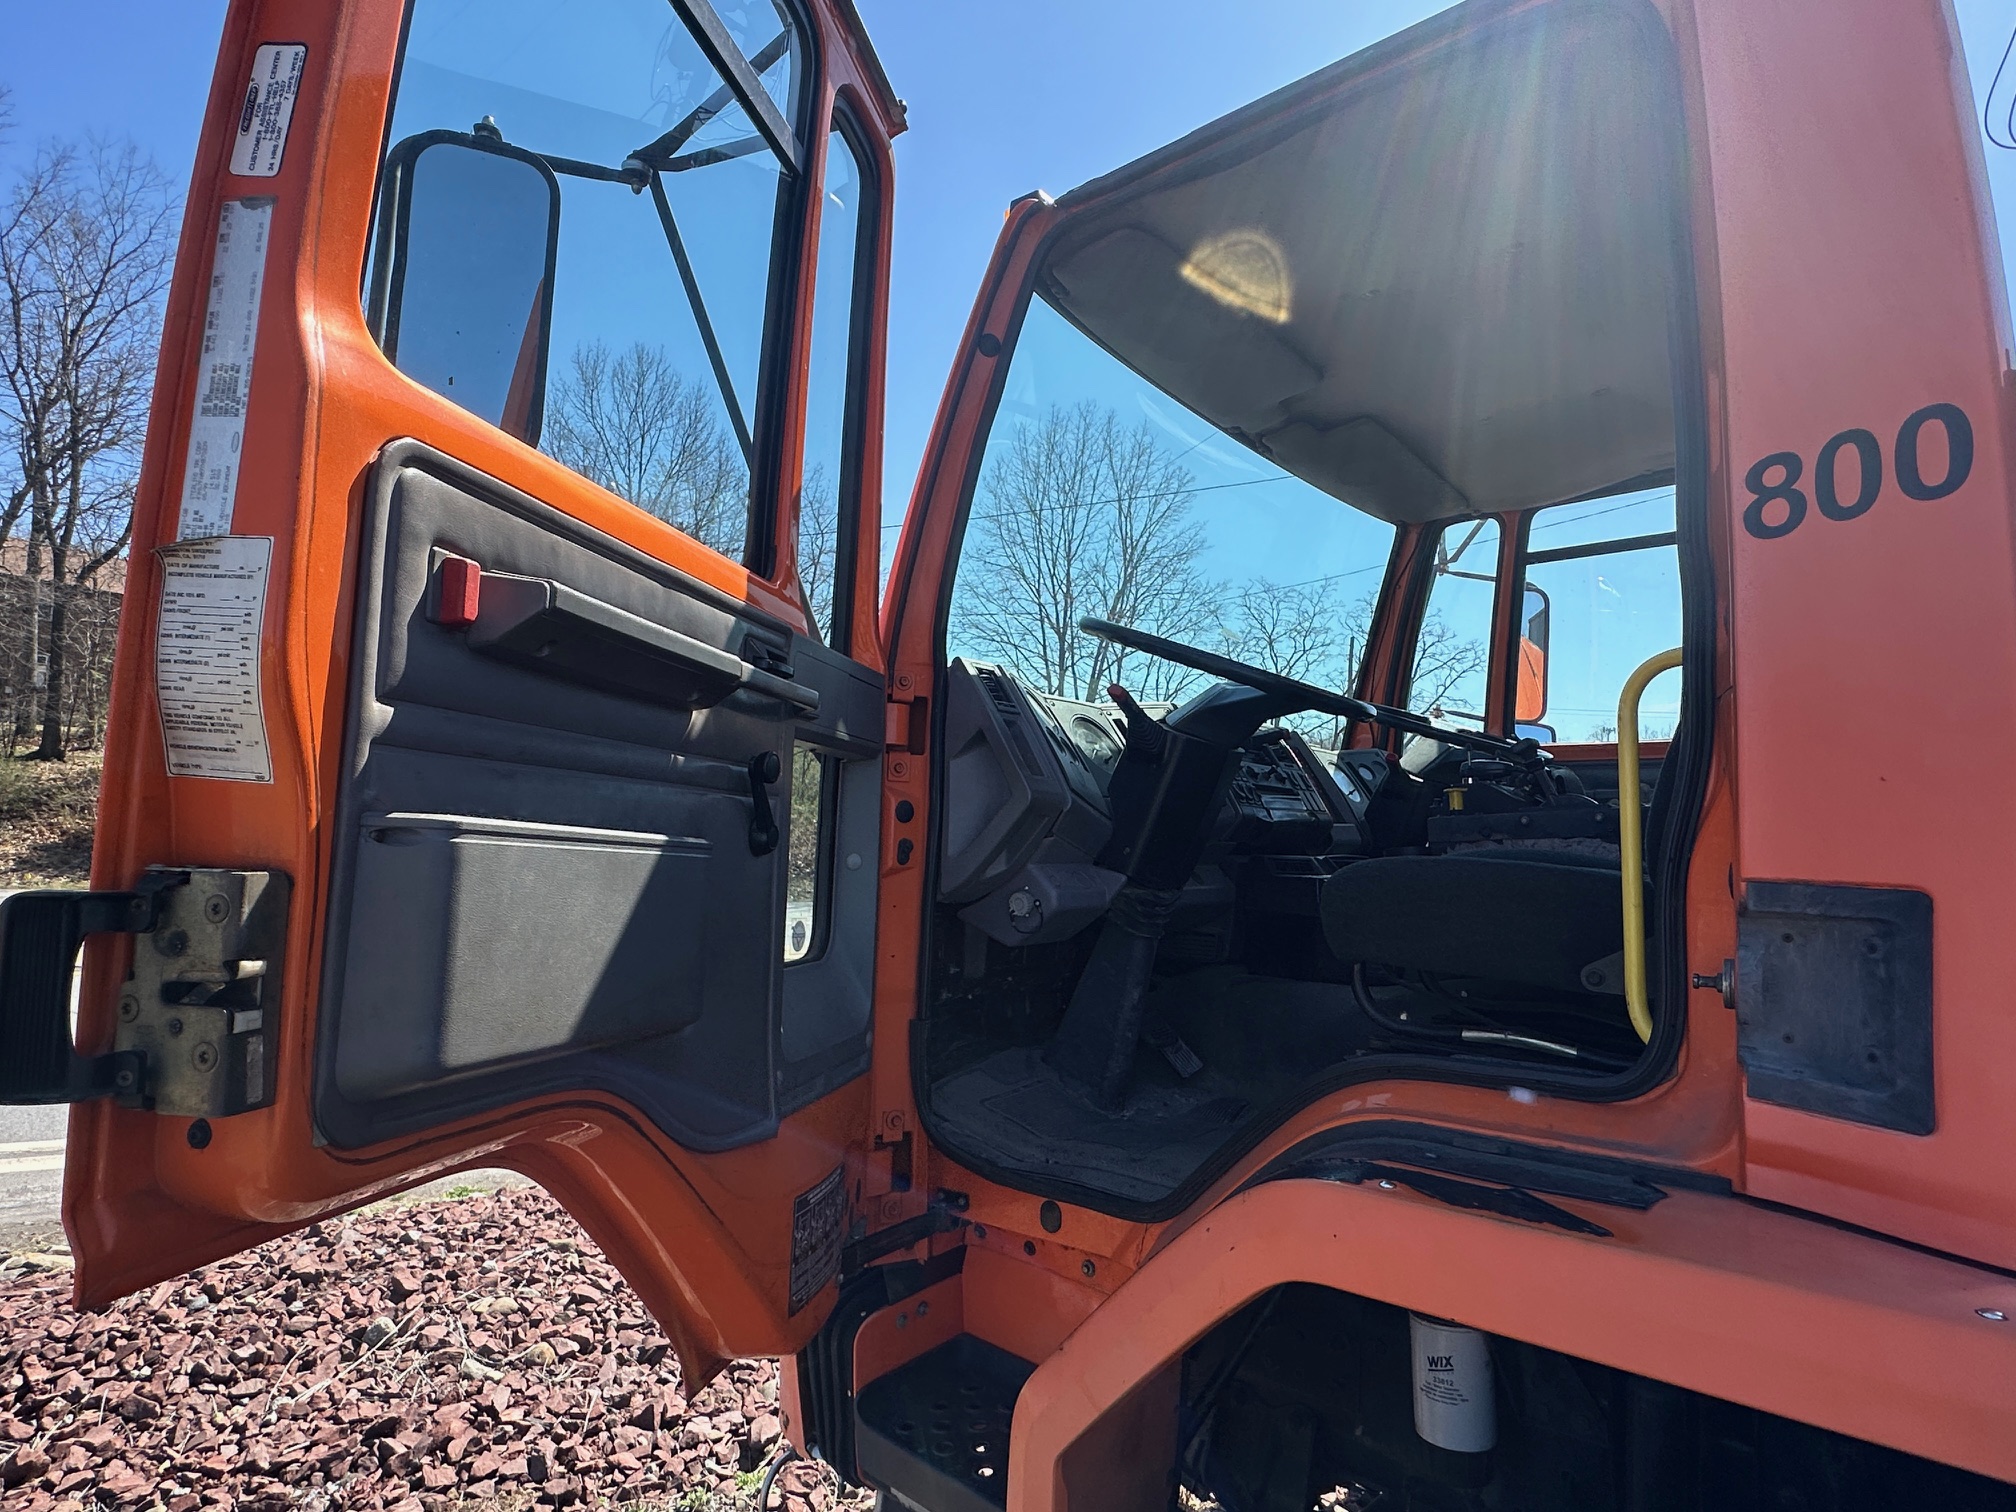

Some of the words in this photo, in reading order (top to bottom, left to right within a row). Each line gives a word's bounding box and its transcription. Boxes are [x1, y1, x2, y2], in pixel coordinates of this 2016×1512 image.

[249, 130, 263, 171] CUSTOMER
[259, 82, 274, 127] ASSISTANCE
[270, 51, 281, 79] CENTER
[255, 102, 263, 117] FOR
[263, 81, 279, 140] 1-800-FTL-HELP
[268, 162, 275, 171] 24
[1743, 402, 1974, 540] 800
[1427, 1356, 1453, 1367] WIX
